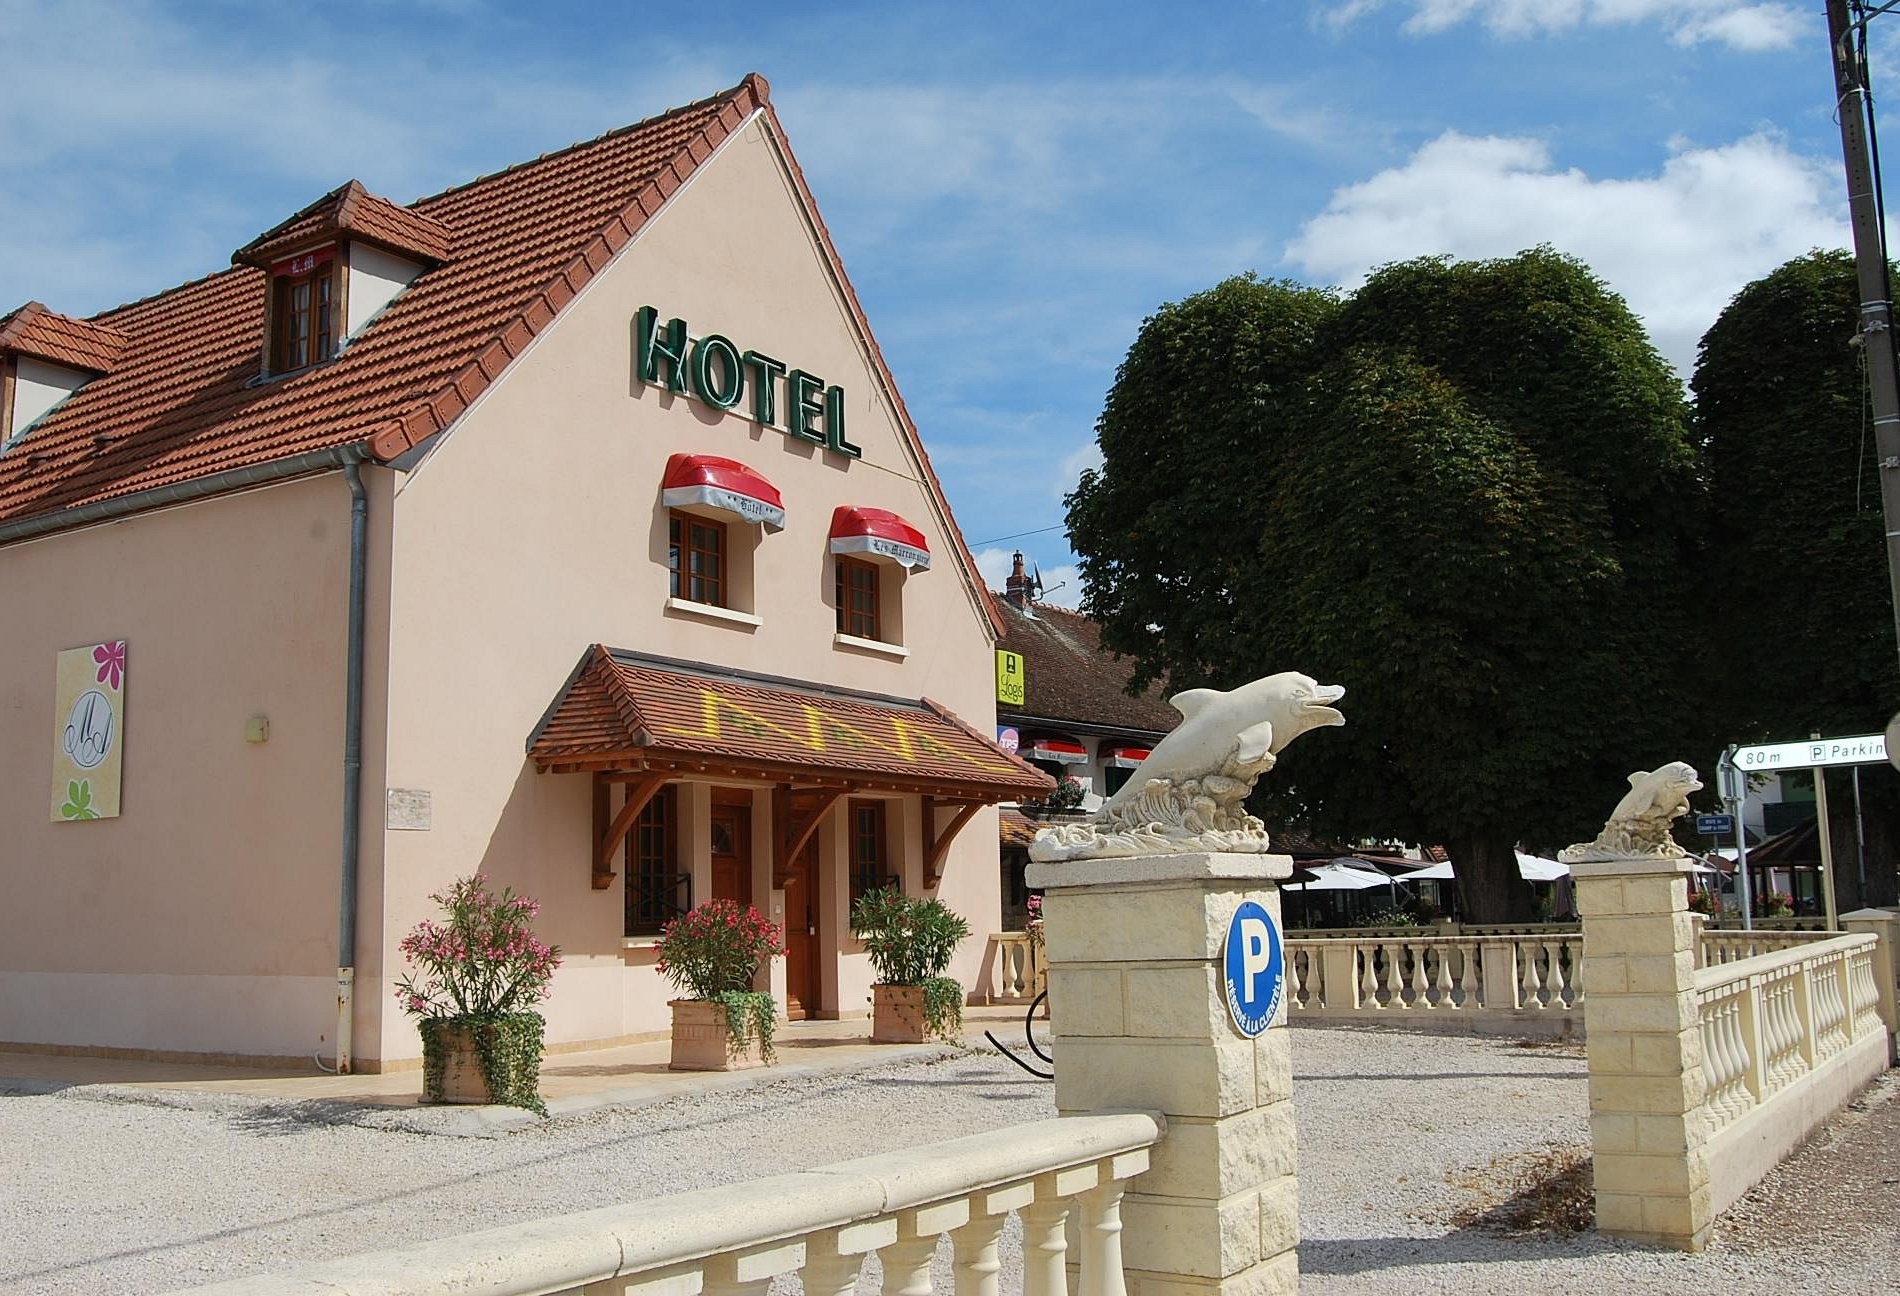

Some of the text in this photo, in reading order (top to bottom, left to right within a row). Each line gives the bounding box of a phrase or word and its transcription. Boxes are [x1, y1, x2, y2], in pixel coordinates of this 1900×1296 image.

[638, 305, 862, 459] HOTEL
[1000, 674, 1023, 702] Logis
[1746, 742, 1884, 765] 80 m P Parkin
[1240, 918, 1270, 1004] P
[1227, 978, 1246, 1029] RÉSERVÉ
[1251, 1020, 1259, 1033] LA
